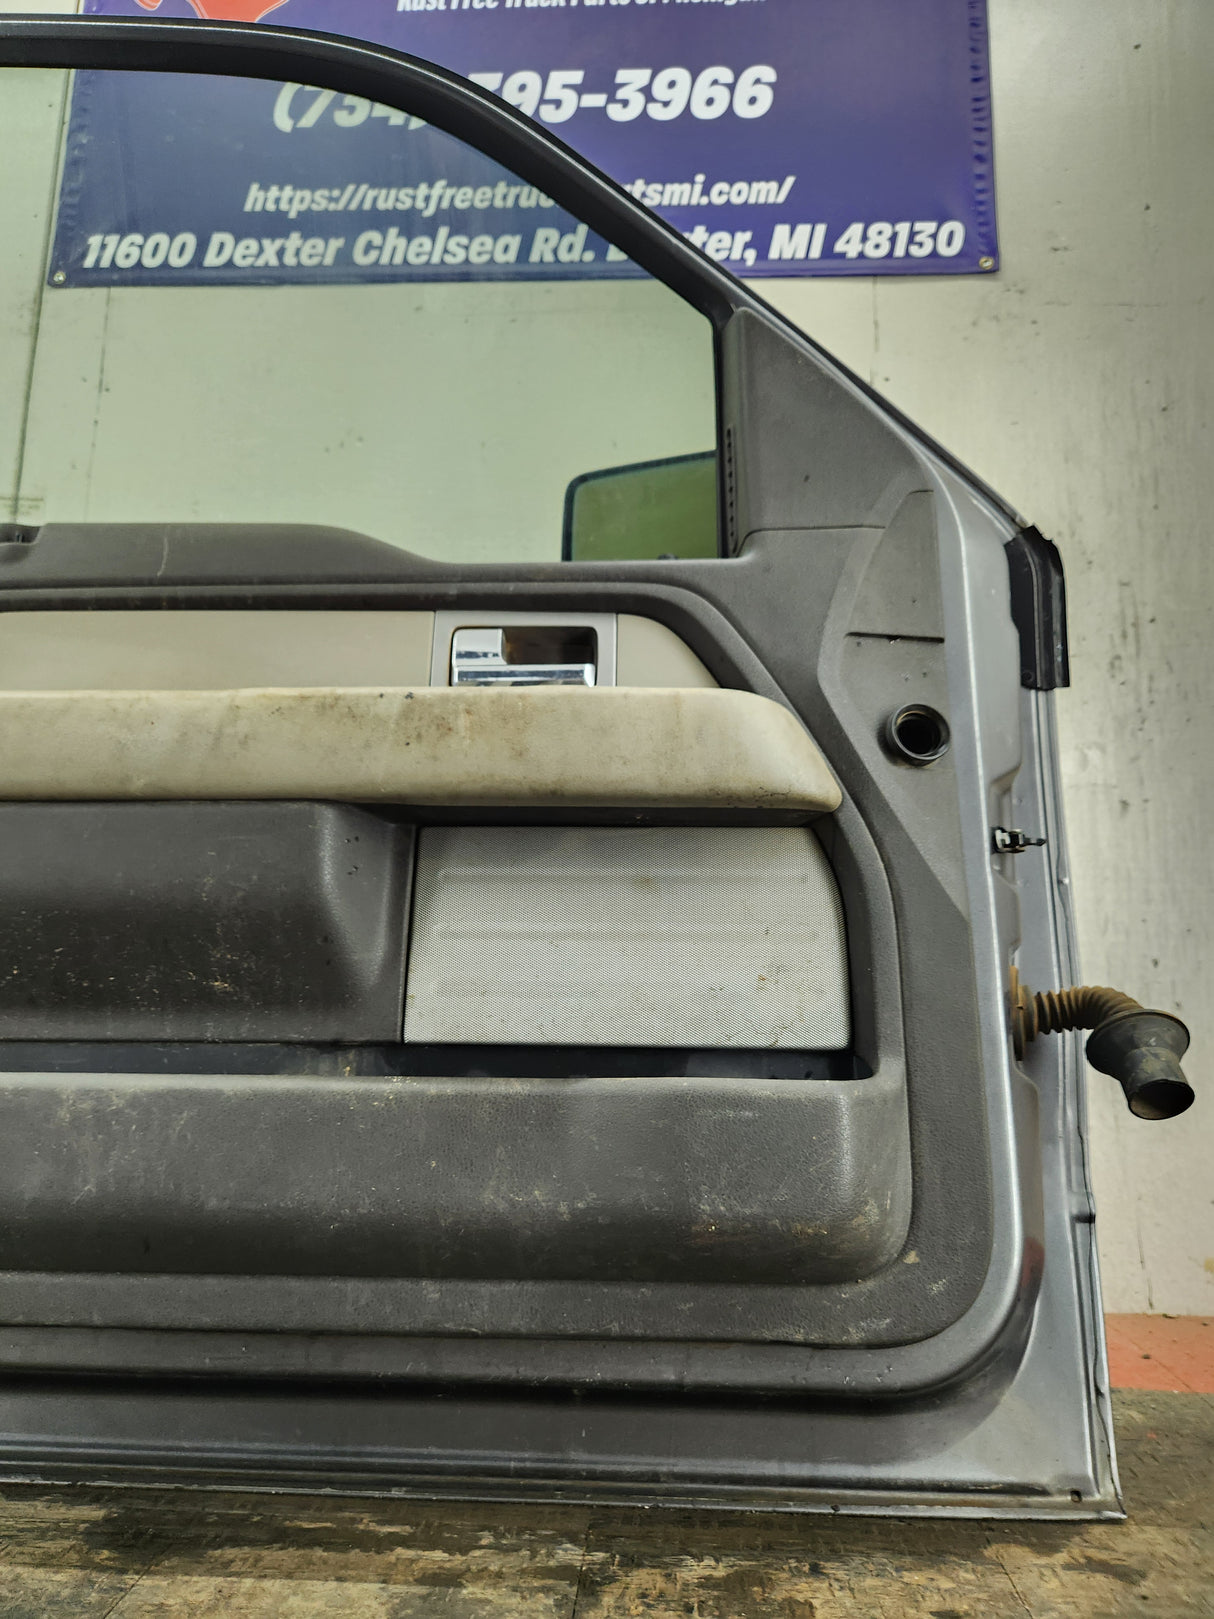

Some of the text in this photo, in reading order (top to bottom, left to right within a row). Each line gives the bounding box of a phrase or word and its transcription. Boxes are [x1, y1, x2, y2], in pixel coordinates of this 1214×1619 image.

[82, 232, 197, 268] 11600
[202, 231, 345, 267] Dexter
[352, 226, 522, 266] Chelsea
[528, 223, 596, 263] Rd.
[767, 223, 828, 260] MI
[833, 220, 966, 258] 48130
